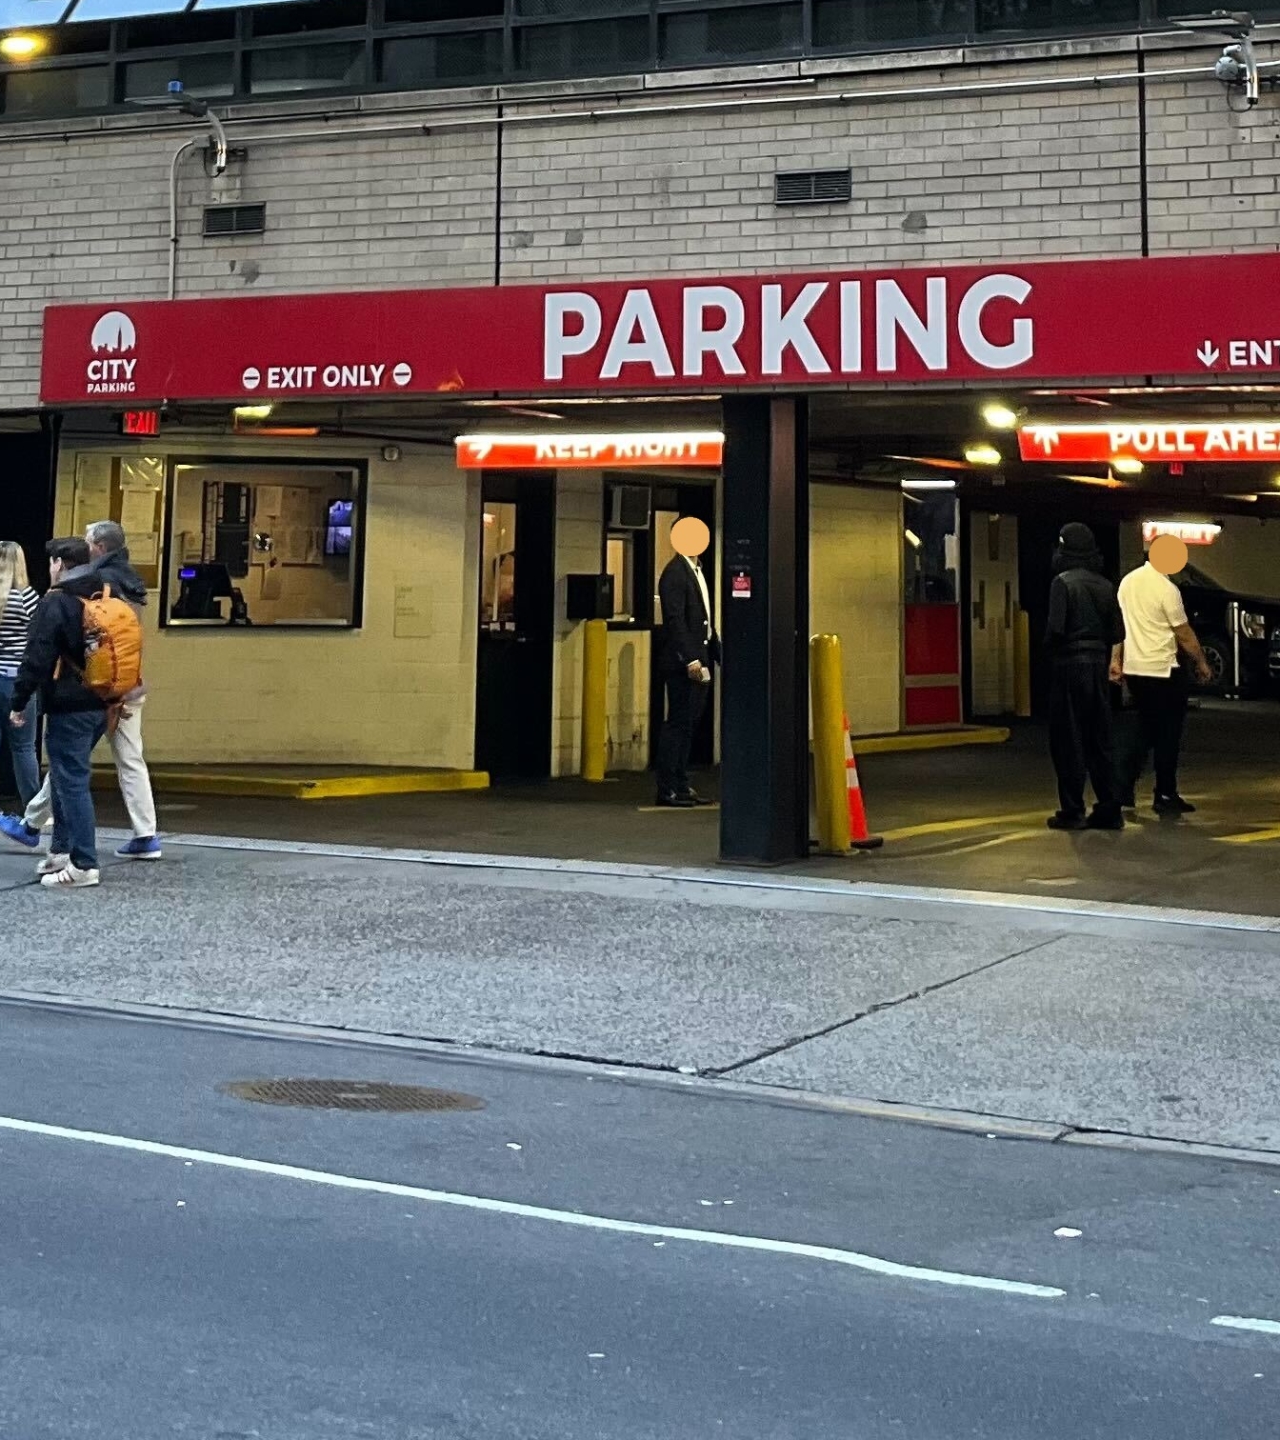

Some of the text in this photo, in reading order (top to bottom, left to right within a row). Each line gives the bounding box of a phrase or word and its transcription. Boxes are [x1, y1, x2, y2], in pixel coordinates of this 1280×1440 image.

[543, 273, 1034, 380] PARKING
[87, 358, 137, 382] CITY
[266, 364, 386, 388] EXIT ONLY
[87, 381, 136, 393] PARKING
[1108, 425, 1195, 452] PULL
